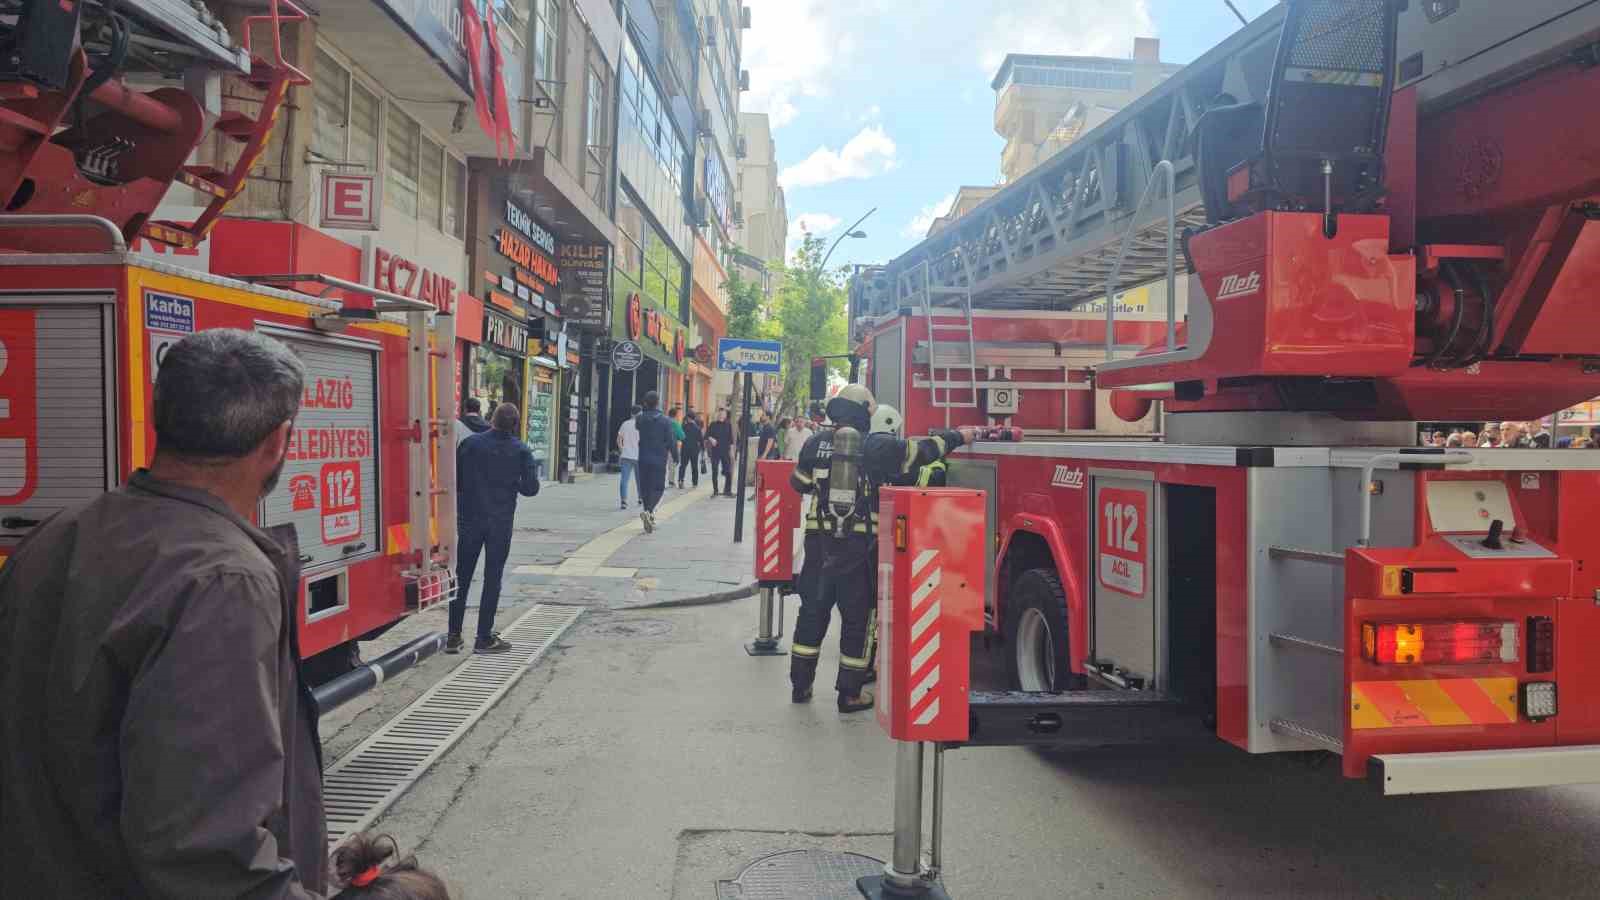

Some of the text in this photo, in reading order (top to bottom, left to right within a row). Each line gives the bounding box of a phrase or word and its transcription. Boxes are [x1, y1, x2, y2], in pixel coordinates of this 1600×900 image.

[334, 182, 363, 216] E
[375, 246, 457, 312] ECZANE
[1215, 271, 1261, 300] Metz
[149, 293, 191, 317] karba
[299, 376, 353, 410] LAZIĞ
[286, 422, 370, 462] ELEDİYESİ
[326, 469, 355, 508] 112
[1051, 464, 1084, 489] Metz
[1104, 501, 1140, 553] 112
